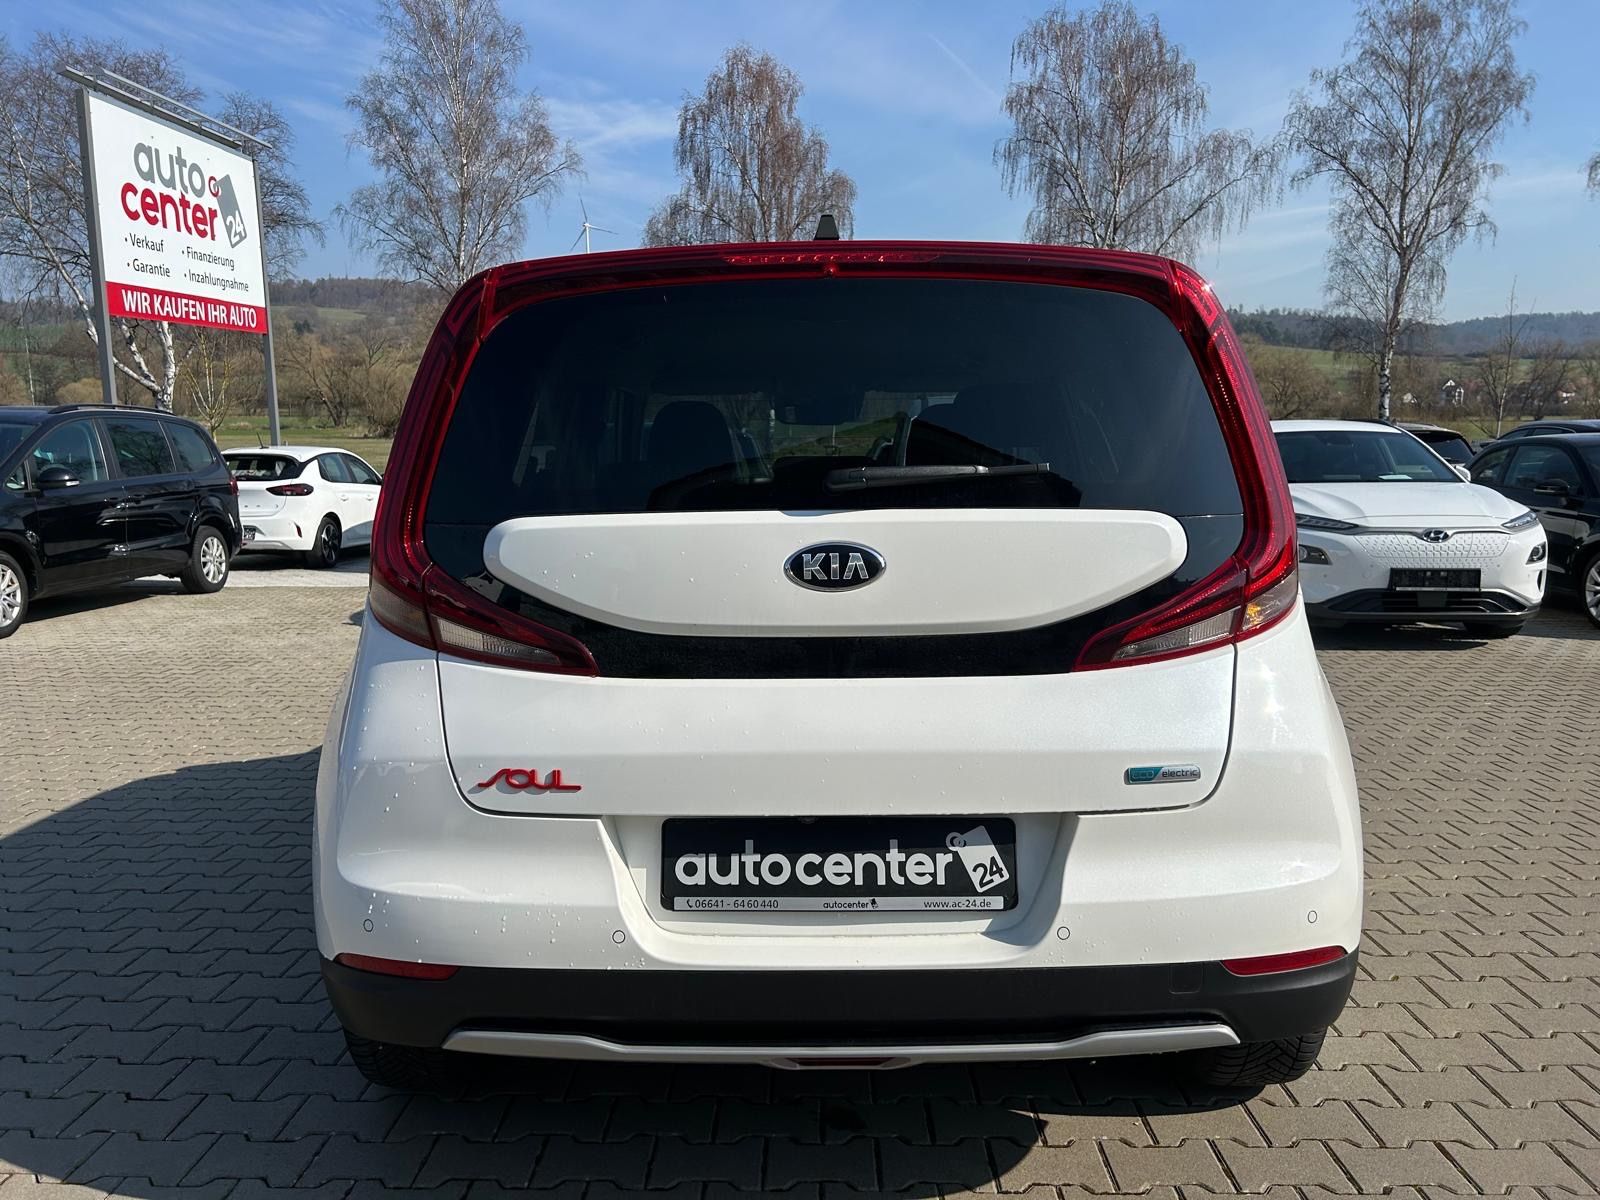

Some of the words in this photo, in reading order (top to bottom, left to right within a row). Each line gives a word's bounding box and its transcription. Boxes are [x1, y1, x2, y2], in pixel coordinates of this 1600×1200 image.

[134, 142, 205, 198] auto
[121, 182, 217, 241] center
[226, 214, 245, 244] 24
[130, 233, 164, 252] Verkauf
[133, 259, 170, 277] Garantie
[186, 247, 235, 271] Finanzierung
[189, 269, 249, 292] Inzahlungnahme
[122, 289, 151, 314] WIR
[154, 294, 205, 320] KAUFEN
[207, 303, 227, 324] IHR
[229, 305, 257, 328] AUTO
[802, 553, 869, 579] KIA
[1162, 768, 1198, 777] electric
[972, 856, 1006, 887] 24
[695, 900, 724, 909] 06641
[823, 901, 869, 909] autocenter
[923, 900, 992, 909] www.ac-24.de
